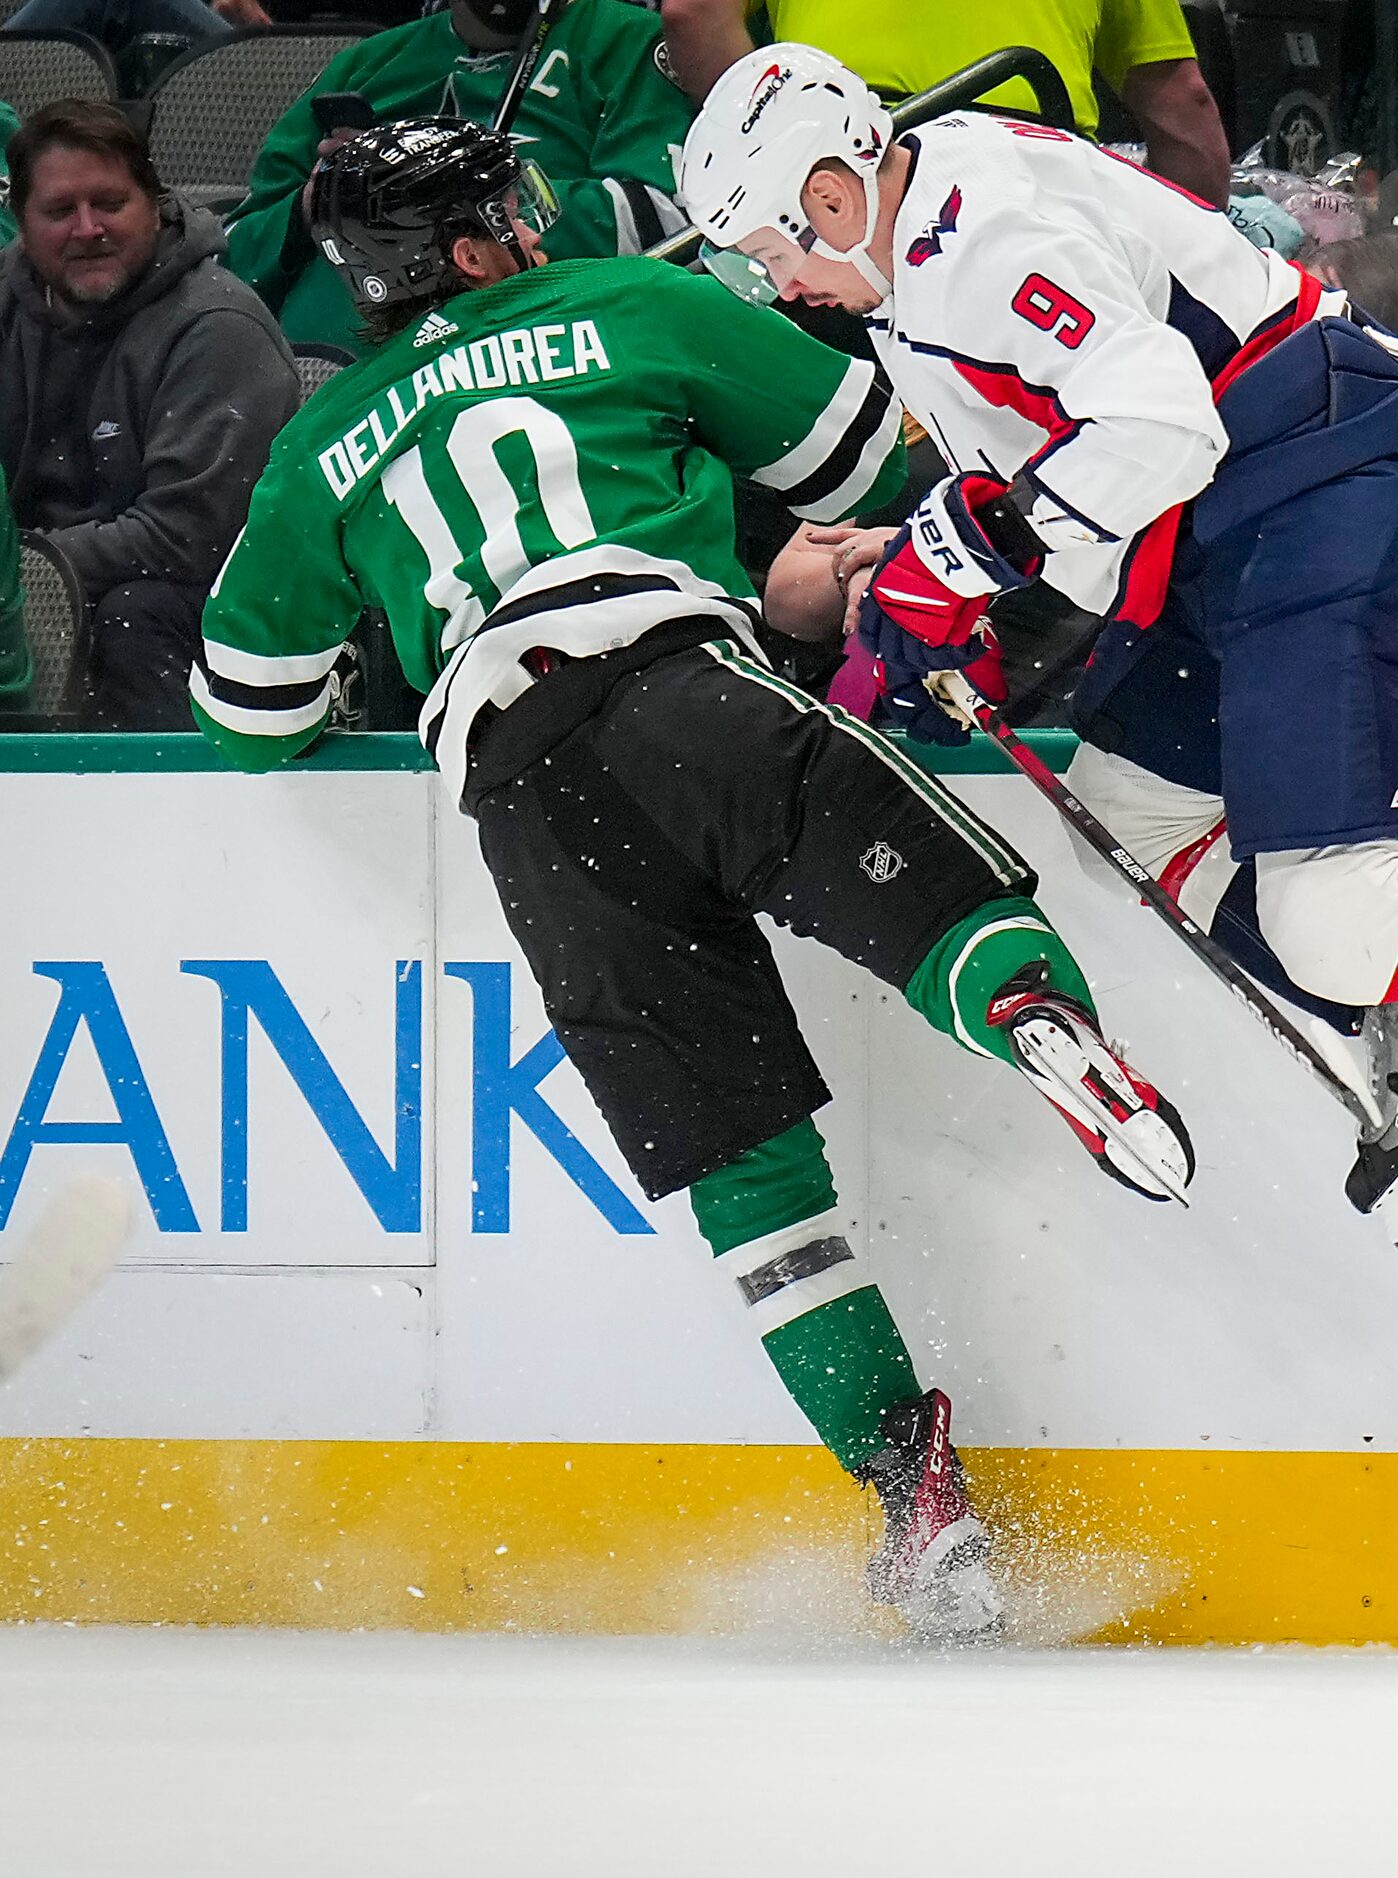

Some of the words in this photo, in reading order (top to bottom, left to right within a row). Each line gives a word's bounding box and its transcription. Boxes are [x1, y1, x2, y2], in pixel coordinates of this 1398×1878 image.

[530, 49, 569, 98] C
[413, 322, 459, 348] adidas
[1011, 272, 1096, 350] 9
[318, 320, 611, 501] DELLANDREA
[381, 396, 598, 653] 10
[1110, 848, 1149, 883] BAUER
[0, 960, 658, 1234] ANK
